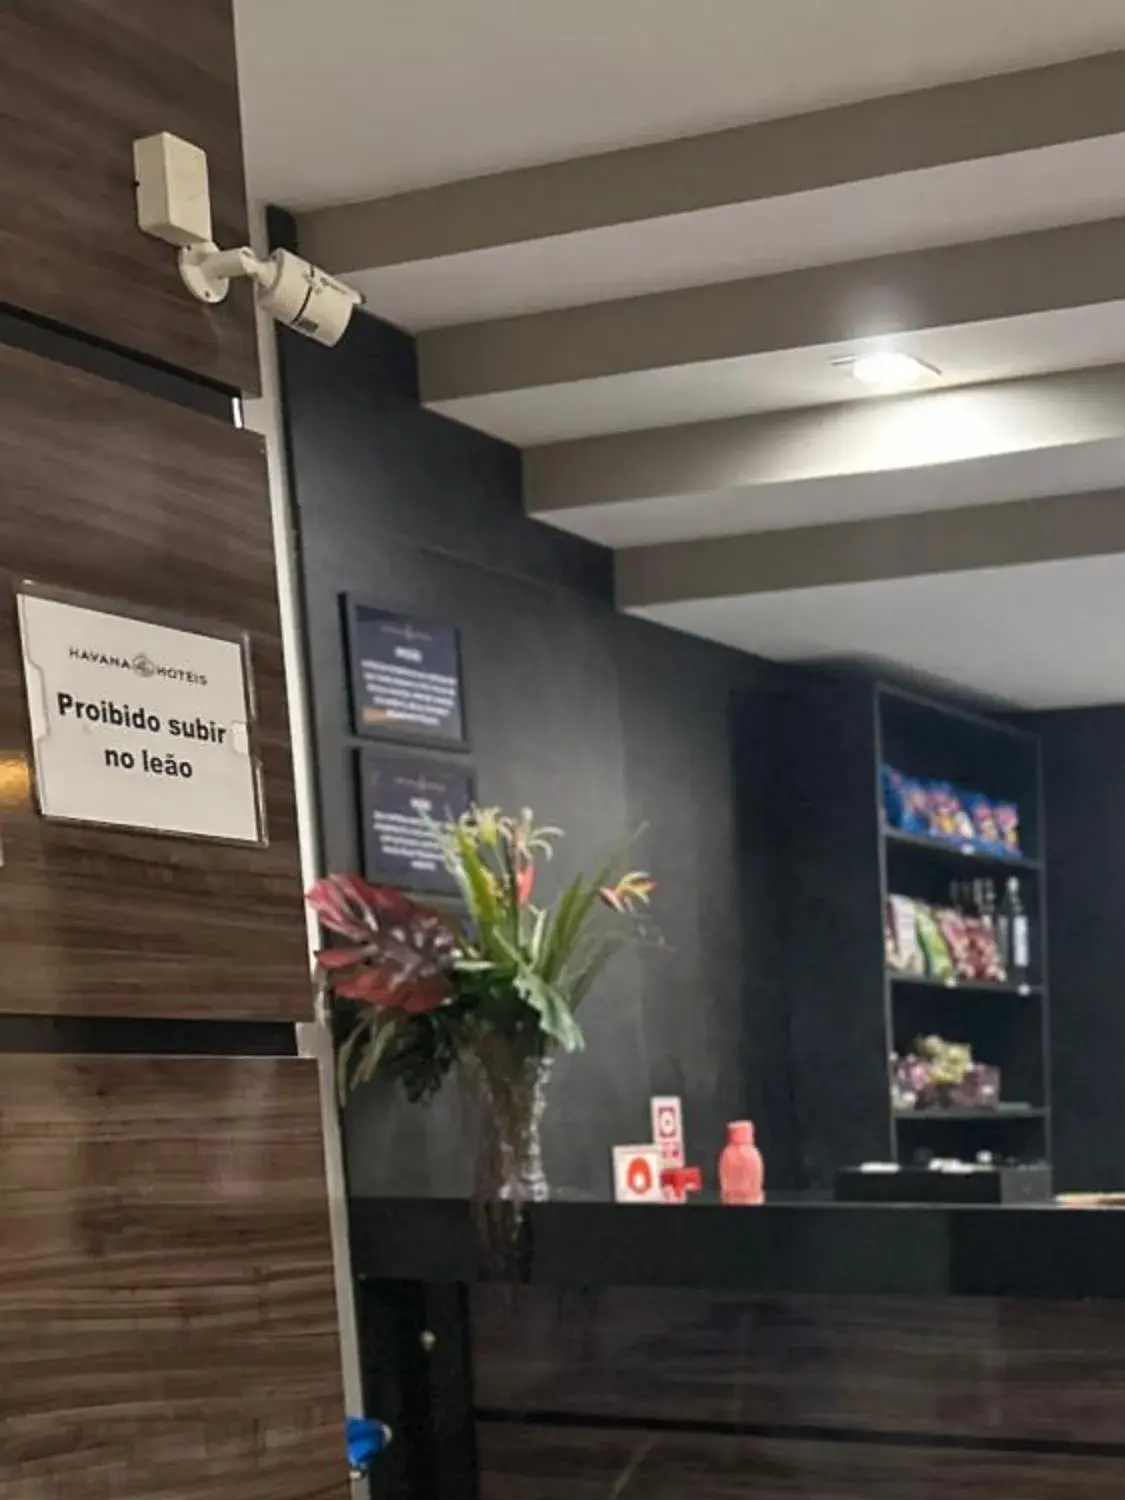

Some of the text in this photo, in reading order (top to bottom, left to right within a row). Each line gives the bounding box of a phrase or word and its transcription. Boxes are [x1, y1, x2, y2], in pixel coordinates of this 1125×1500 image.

[69, 647, 131, 669] HAVANA
[57, 692, 227, 744] Proibido subir
[104, 749, 193, 778] no leão
